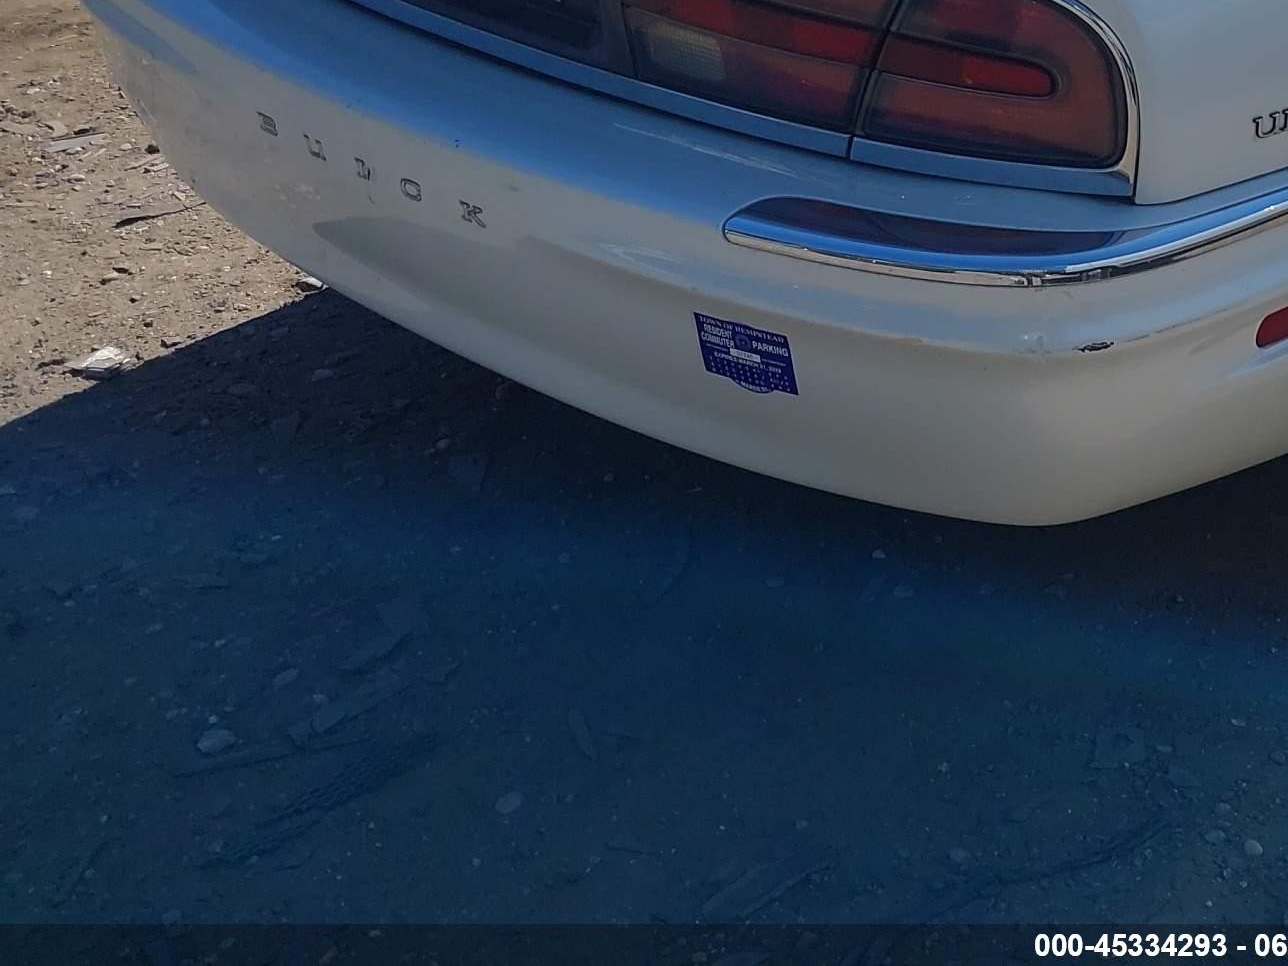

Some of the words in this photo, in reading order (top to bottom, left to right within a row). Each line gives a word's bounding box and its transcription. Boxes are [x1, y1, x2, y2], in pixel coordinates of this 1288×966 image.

[256, 110, 487, 228] BUICK
[701, 332, 735, 349] COMMUTER
[752, 340, 789, 357] PARKING
